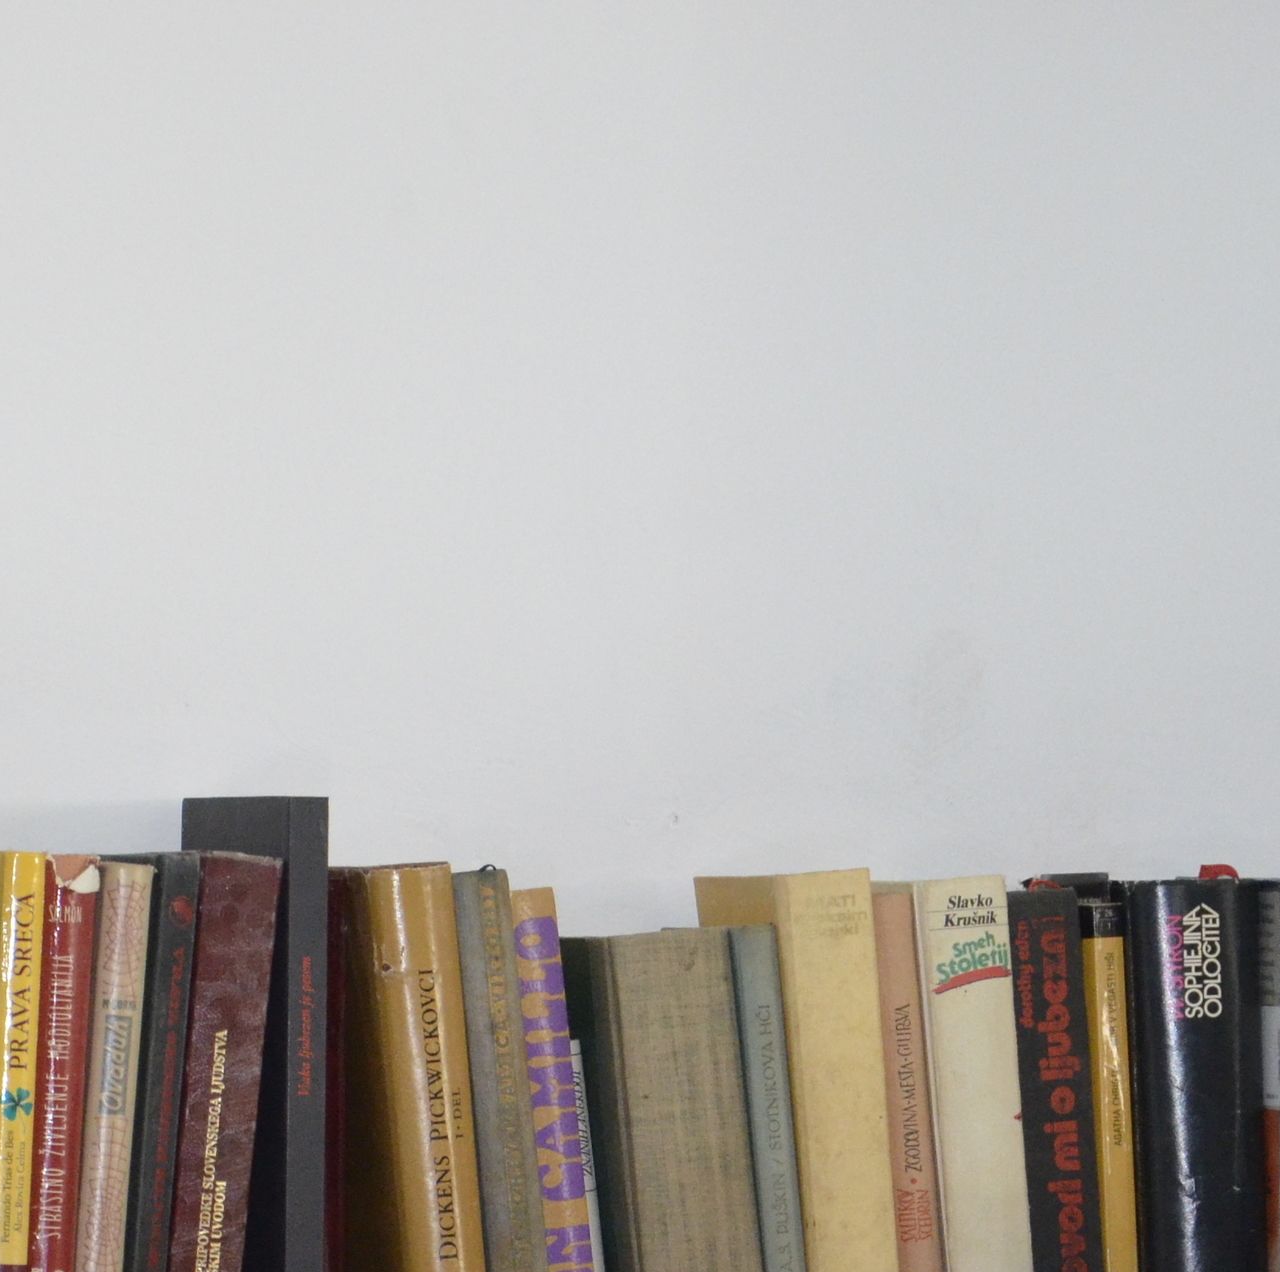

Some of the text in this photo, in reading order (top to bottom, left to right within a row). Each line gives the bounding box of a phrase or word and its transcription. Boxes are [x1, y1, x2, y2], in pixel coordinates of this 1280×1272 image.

[943, 910, 997, 927] Krušnik
[947, 894, 993, 910] Slavko
[952, 932, 996, 953] Smeh
[1182, 905, 1203, 1018] SOPHIEJINA
[1201, 903, 1222, 1017] ODLOČITEV
[9, 997, 30, 1071] PRAVA
[210, 1029, 228, 1093] LJUDSTVA
[514, 916, 586, 1201] CAMILLO
[419, 969, 459, 1261] DICKENS PICKWICKOVCI
[762, 1041, 780, 1150] STOTNIKOVA
[1049, 1086, 1076, 1113] o
[202, 1097, 223, 1190] SLOVENSKEGA
[1044, 1121, 1081, 1171] mi
[211, 1181, 227, 1238] UVODOM
